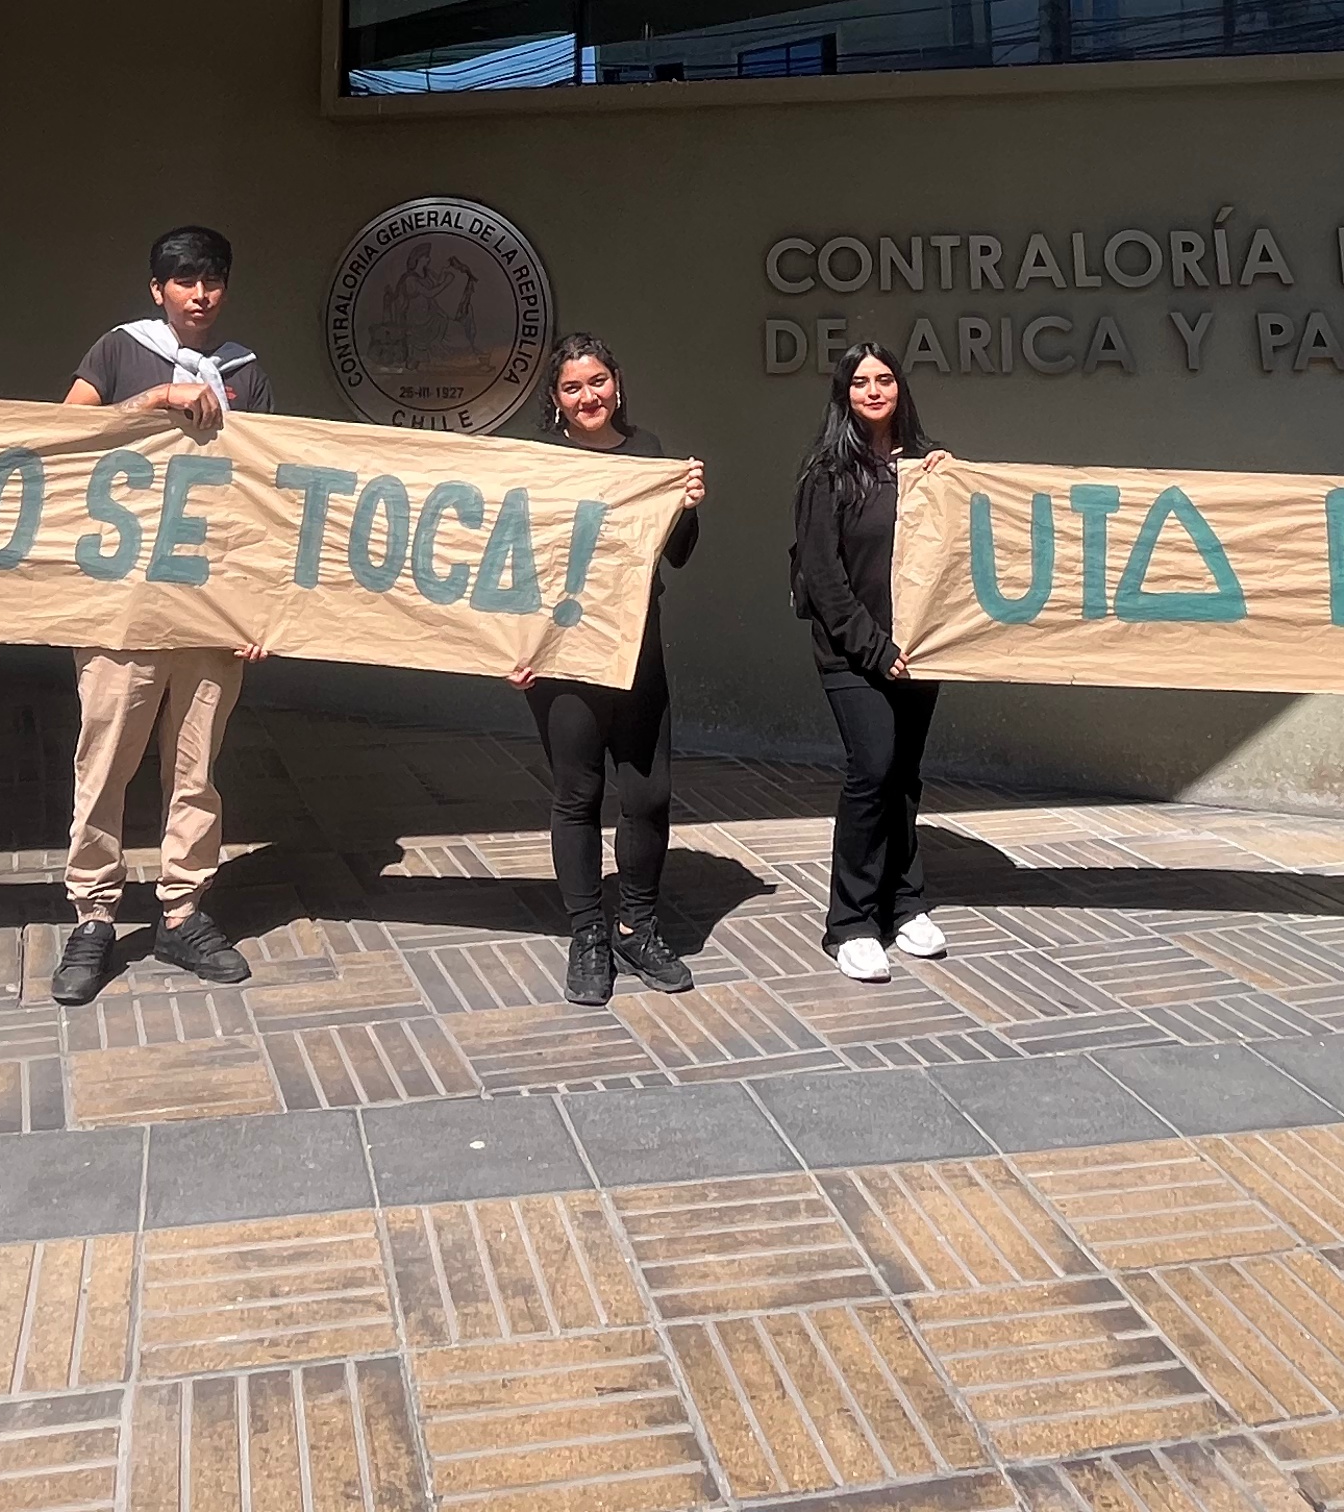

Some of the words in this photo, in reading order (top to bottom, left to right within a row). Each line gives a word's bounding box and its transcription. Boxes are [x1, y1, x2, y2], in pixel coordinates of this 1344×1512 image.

[375, 210, 464, 246] GENERAL
[468, 218, 496, 243] DE
[492, 235, 519, 266] LA
[765, 206, 1294, 294] CONTRALORÍA
[332, 245, 380, 388] CONTRALORIA
[503, 264, 539, 386] REPUBLICA
[765, 317, 847, 375] DE
[902, 316, 1136, 375] ARICA
[1170, 312, 1213, 372] Y
[392, 409, 474, 432] CHILE
[74, 449, 233, 587] SE
[275, 462, 610, 629] TOCA!
[969, 484, 1248, 625] UTA
